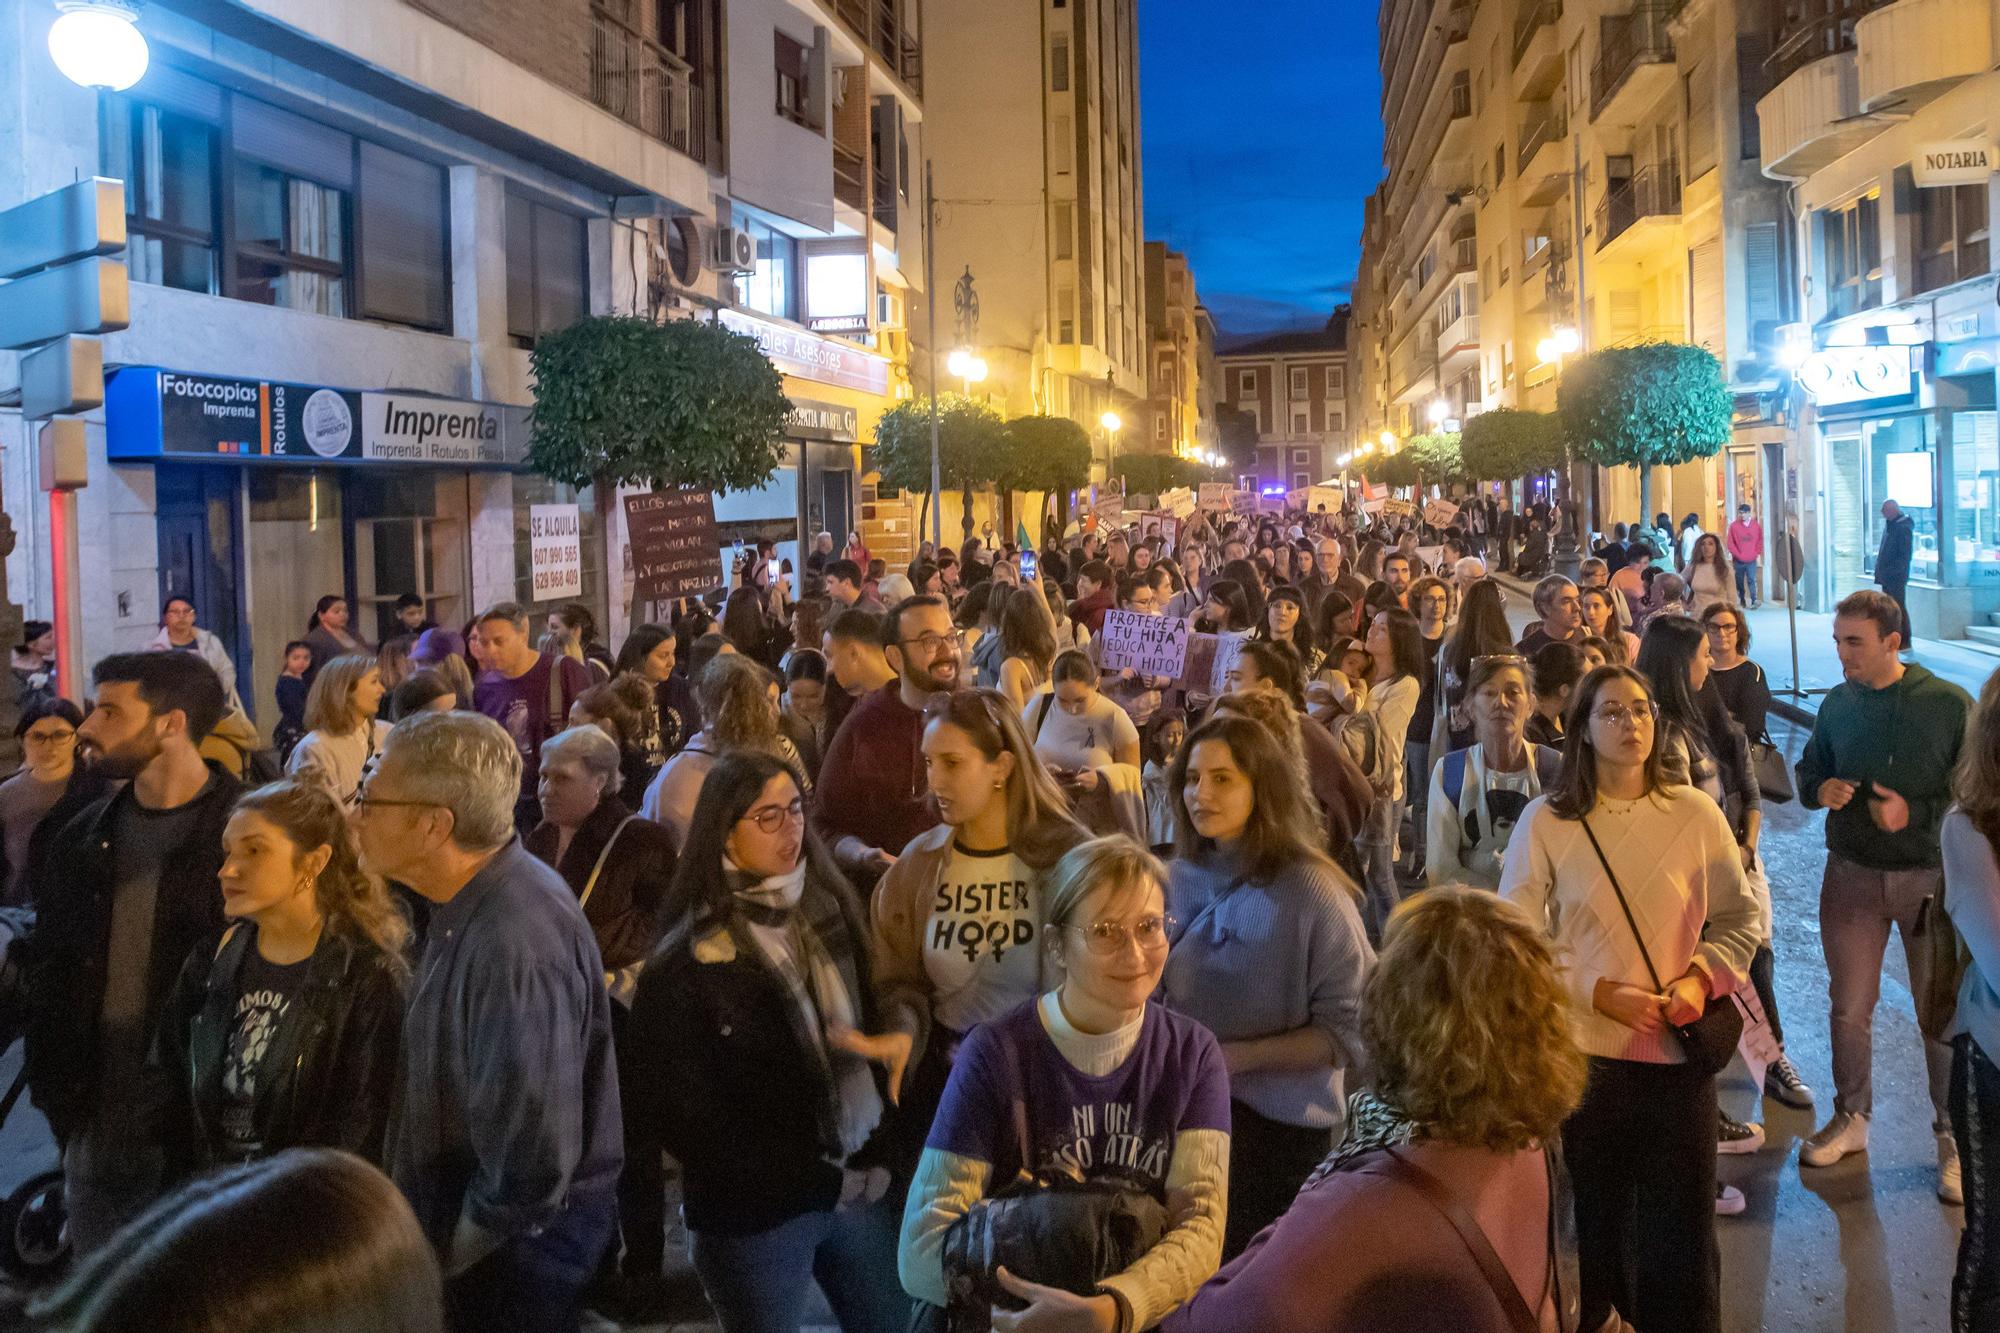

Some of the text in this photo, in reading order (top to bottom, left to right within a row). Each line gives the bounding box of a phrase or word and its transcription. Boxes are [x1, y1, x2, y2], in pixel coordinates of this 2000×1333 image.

[1925, 150, 1988, 170] NOTARIA
[792, 336, 842, 369] Asesores
[162, 374, 258, 403] Fotocopias
[203, 401, 256, 418] Imprenta
[273, 385, 286, 455] Rotulos
[820, 409, 843, 431] MARFIL
[384, 400, 498, 444] Imprenta
[372, 441, 422, 459] Imprenta
[431, 443, 470, 459] Rotulos
[629, 496, 665, 512] ELLOS
[532, 515, 578, 538] SE ALQUILA
[534, 547, 548, 565] 607
[535, 571, 549, 590] 629
[550, 570, 564, 588] 968
[1109, 611, 1186, 634] PROTEGE A
[1113, 625, 1176, 645] TU HIJA
[1154, 643, 1164, 656] A
[1114, 653, 1180, 677] TU HIJO!
[935, 880, 1029, 914] SISTER
[932, 918, 1034, 963] HOOD
[1072, 1102, 1132, 1138] NI UN
